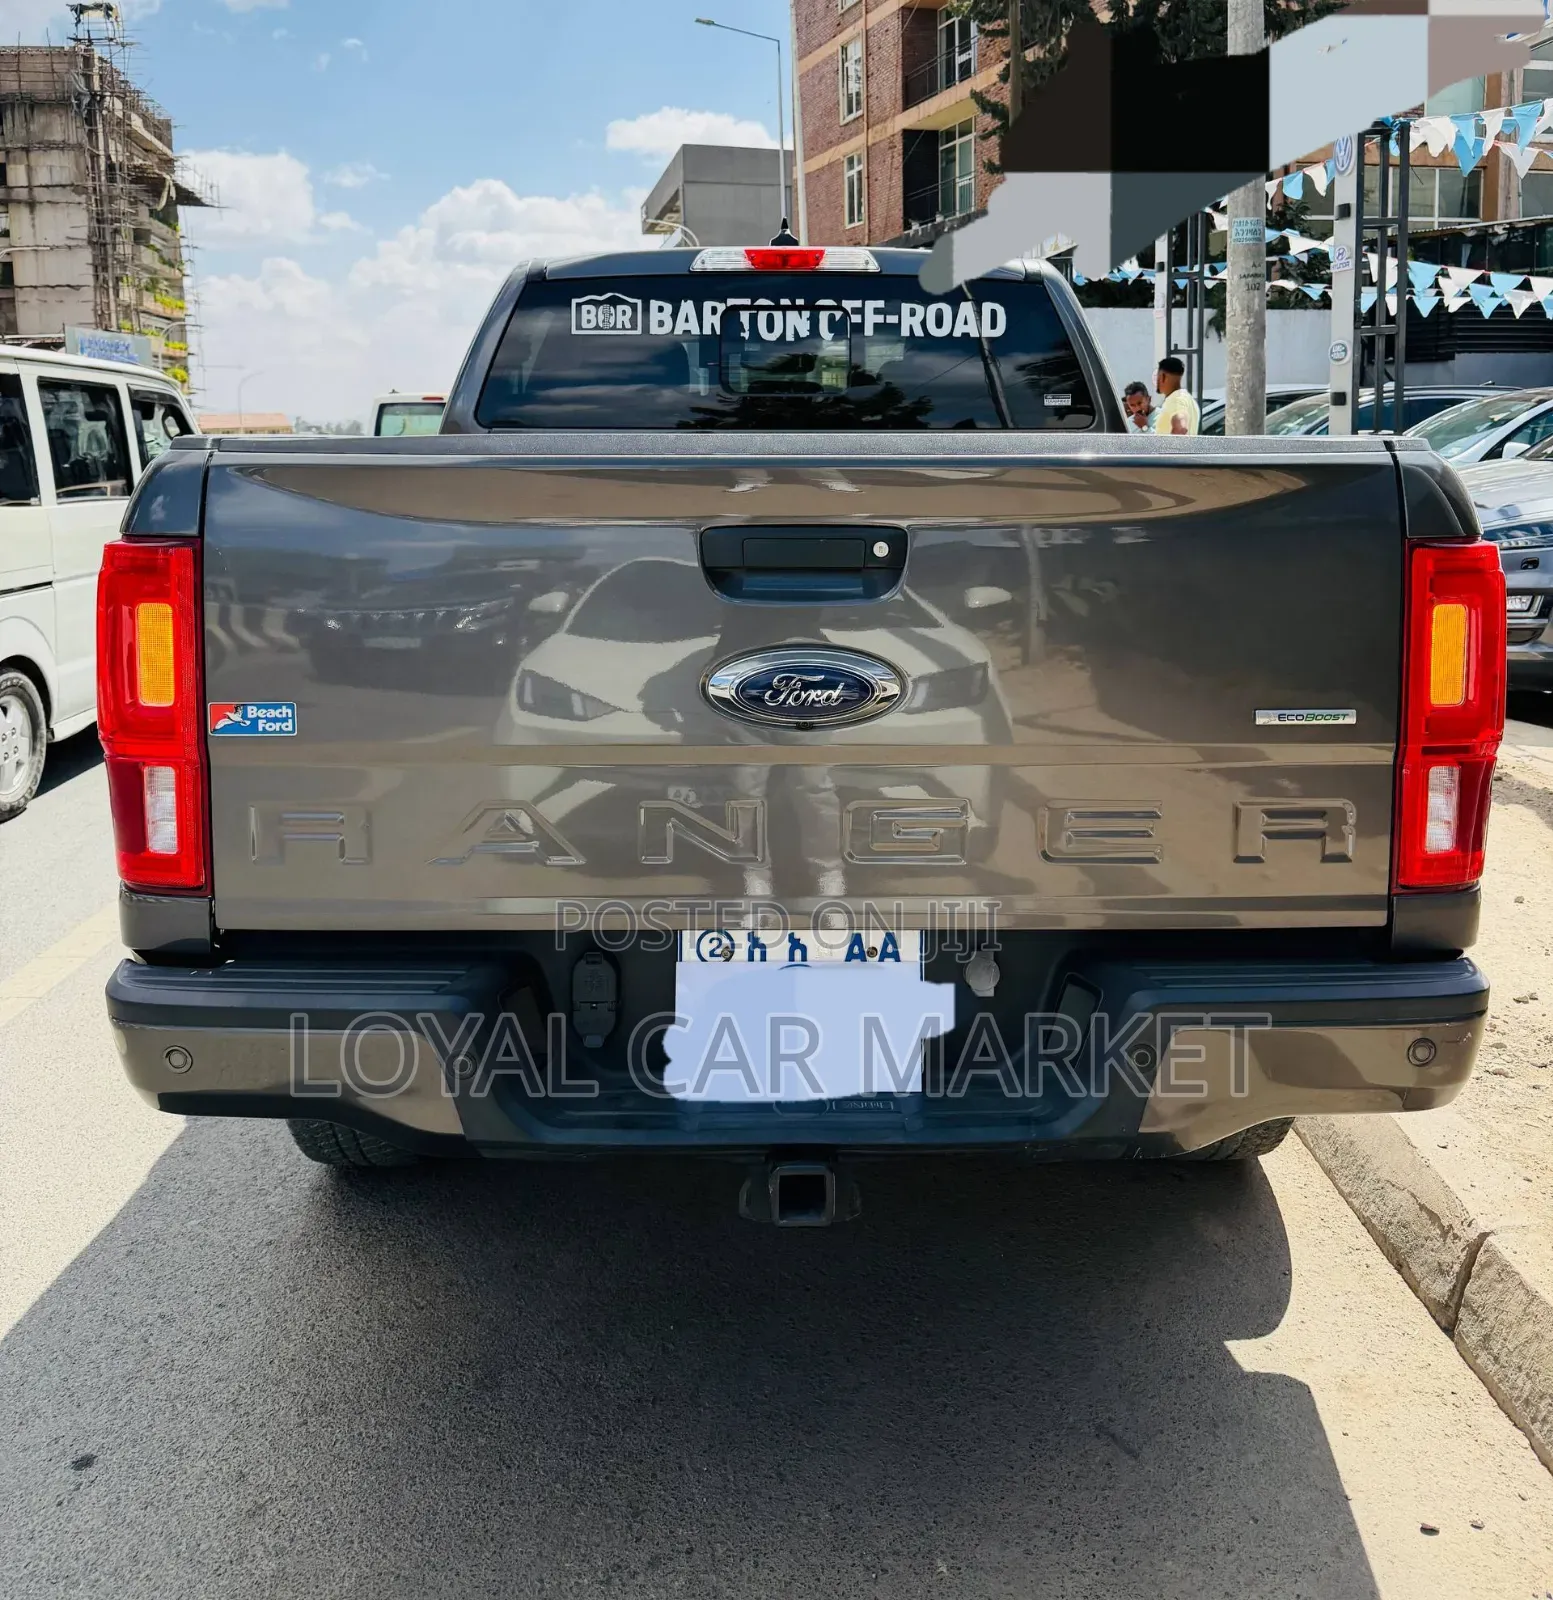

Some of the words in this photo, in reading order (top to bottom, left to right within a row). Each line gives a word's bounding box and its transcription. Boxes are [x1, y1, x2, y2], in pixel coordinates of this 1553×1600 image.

[650, 298, 810, 341] BARTON
[815, 299, 1007, 341] OFF-ROAD
[764, 673, 845, 707] Ford
[247, 705, 292, 719] Beach
[257, 719, 293, 732] Ford
[248, 800, 1357, 867] RANGER
